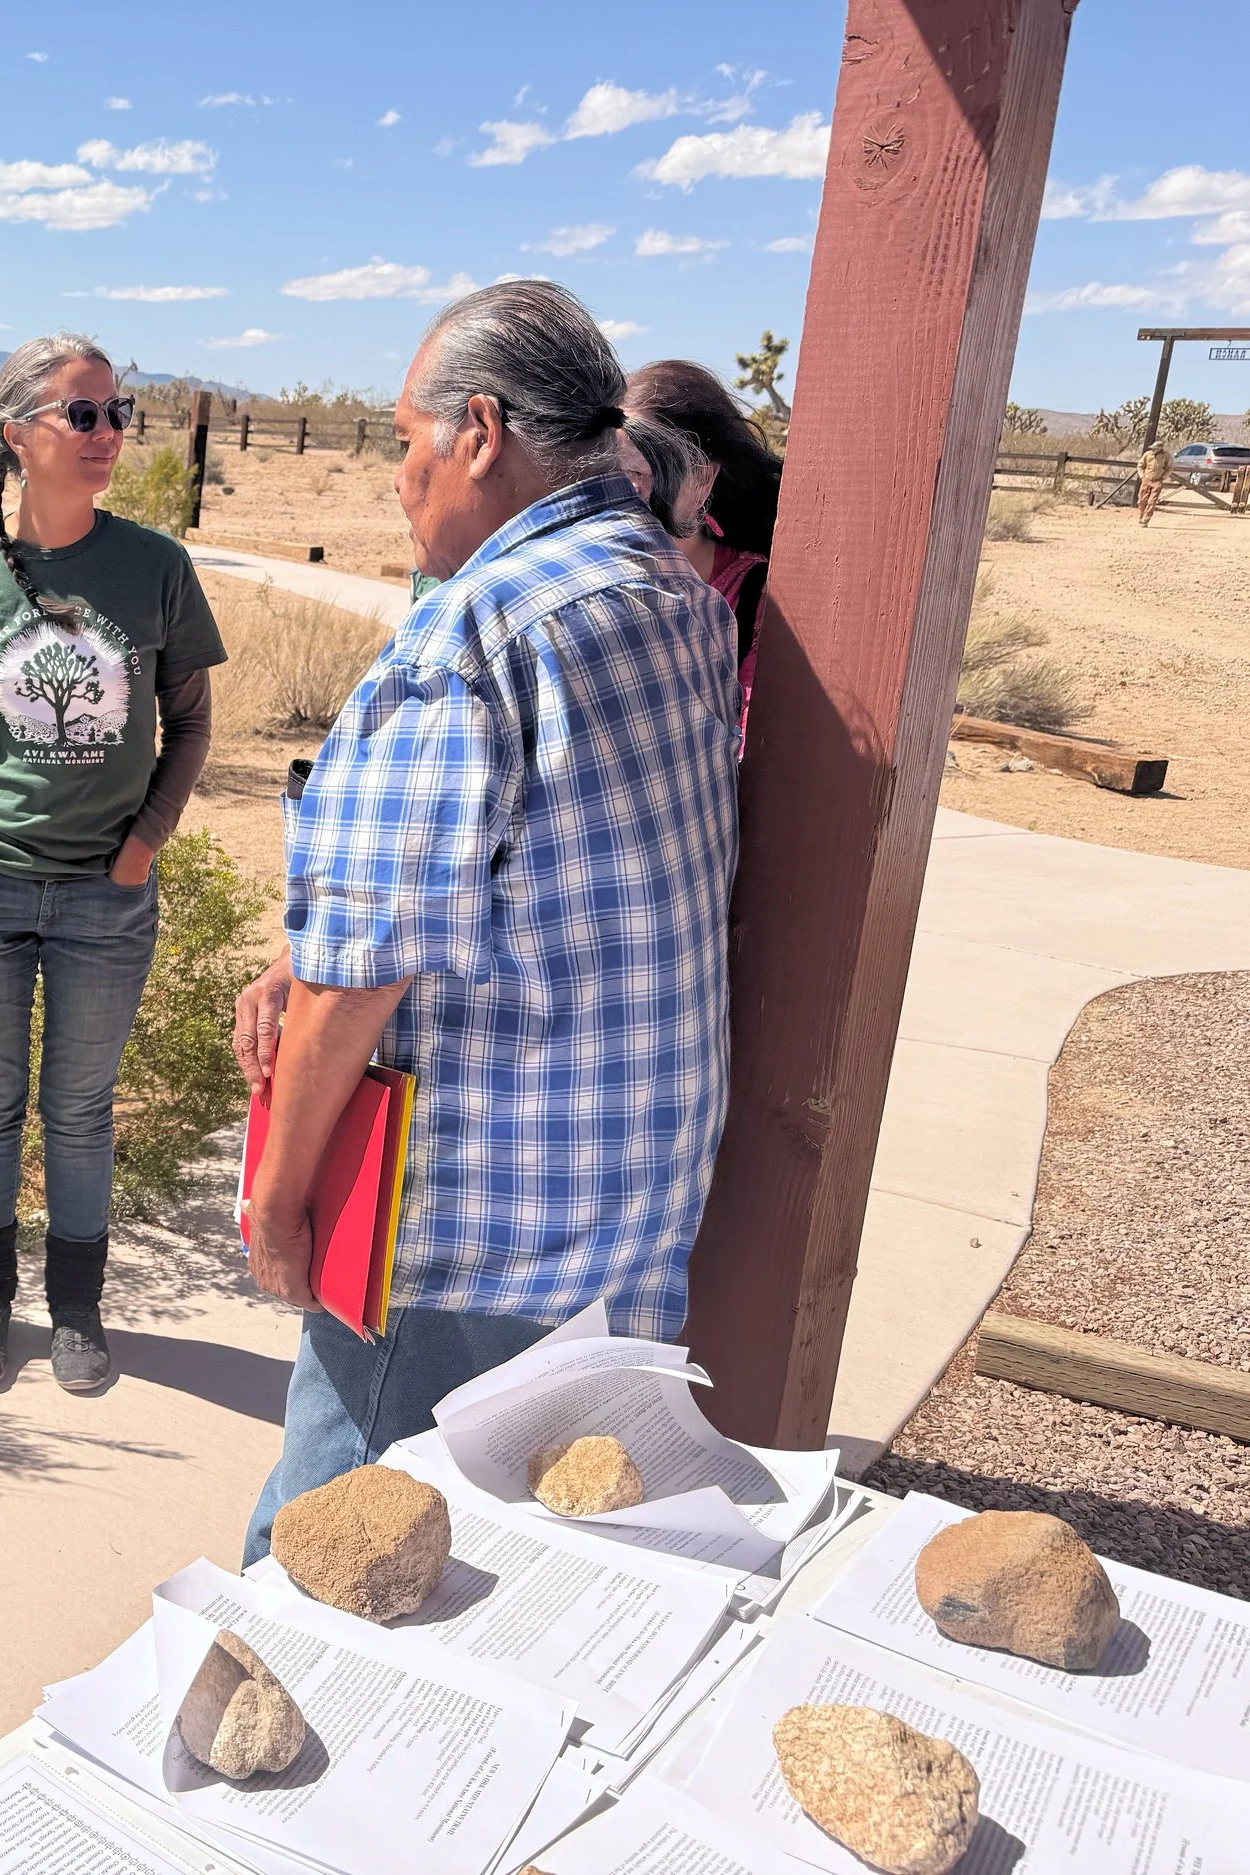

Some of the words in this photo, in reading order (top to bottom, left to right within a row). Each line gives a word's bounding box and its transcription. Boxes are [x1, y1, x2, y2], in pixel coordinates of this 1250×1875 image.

[97, 613, 129, 644] WITH
[128, 646, 142, 676] YOU
[22, 757, 61, 765] NATIONAL
[23, 749, 44, 758] AVI
[49, 750, 77, 758] KWA
[82, 750, 105, 758] AME
[477, 1773, 492, 1789] YORK
[456, 1788, 482, 1820] MOUNTAINS
[445, 1819, 462, 1837] TRAIL
